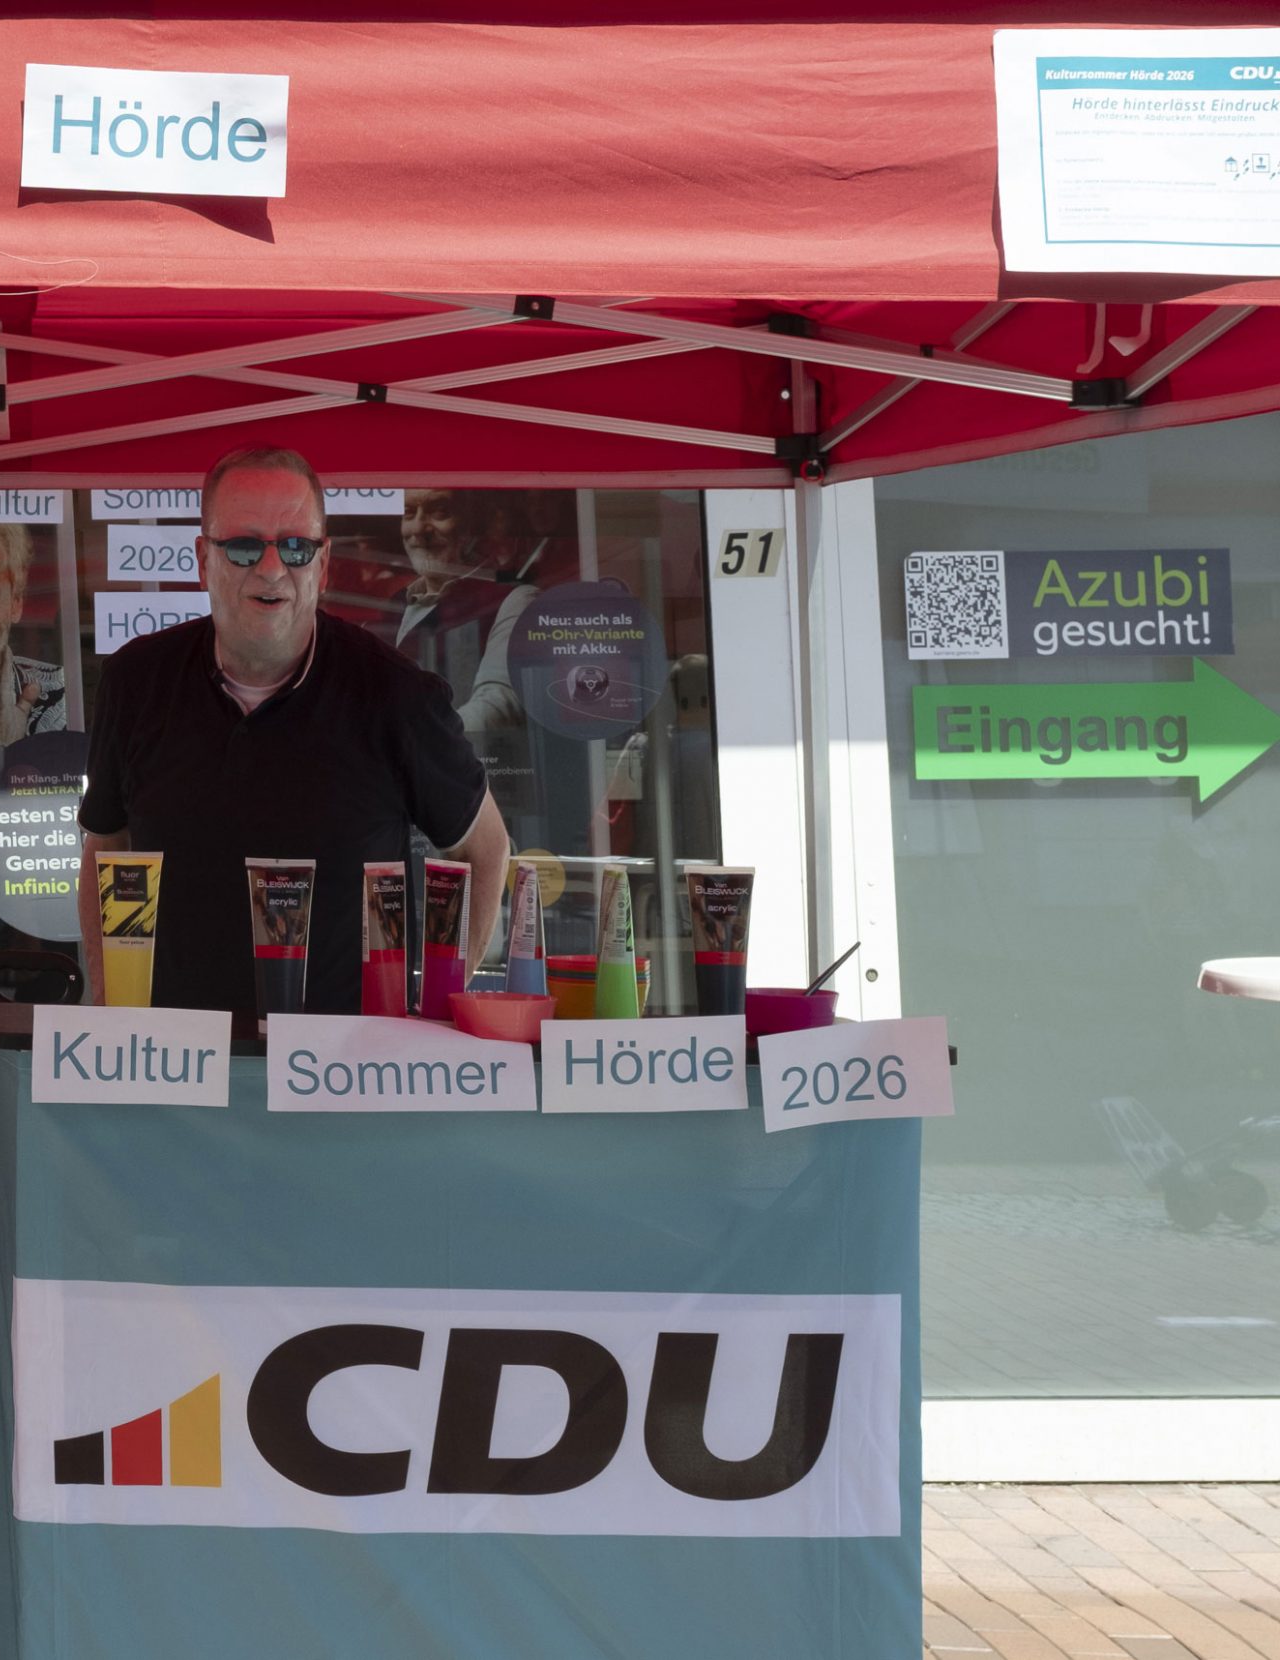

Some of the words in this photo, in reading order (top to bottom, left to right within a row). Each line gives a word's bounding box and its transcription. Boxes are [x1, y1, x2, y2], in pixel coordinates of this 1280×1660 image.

[1045, 68, 1128, 81] Kultursommer
[1130, 69, 1164, 81] Hörde
[1166, 70, 1195, 82] 2026
[1230, 66, 1274, 80] CDU
[1072, 97, 1118, 111] Hörde
[1123, 97, 1206, 112] hinterlässt
[53, 95, 268, 162] Hörde
[104, 490, 201, 510] Somm
[120, 545, 194, 572] 2026
[722, 531, 774, 575] 51
[1033, 556, 1209, 607] Azubi
[538, 614, 572, 626] Neu:
[574, 614, 610, 626] auch
[612, 613, 632, 625] als
[528, 629, 645, 641] Im-Ohr-Variante
[1033, 610, 1211, 655] gesucht!
[553, 644, 577, 655] mit
[579, 643, 621, 655] Akku.
[937, 706, 1189, 764] Eingang
[487, 766, 535, 777] sprobieren
[10, 786, 37, 797] Jetzt
[38, 785, 75, 796] ULTRA
[59, 806, 79, 823] Si
[0, 831, 39, 848] hier
[43, 830, 76, 847] die
[6, 856, 81, 871] Genera
[4, 878, 71, 896] Infinio
[269, 898, 298, 908] acrylic
[708, 904, 737, 913] acrylic
[54, 1031, 216, 1083] Kultur
[565, 1036, 734, 1085] Hörde
[287, 1050, 507, 1096] Sommer
[781, 1055, 907, 1111] 2026
[247, 1324, 845, 1500] CDU
